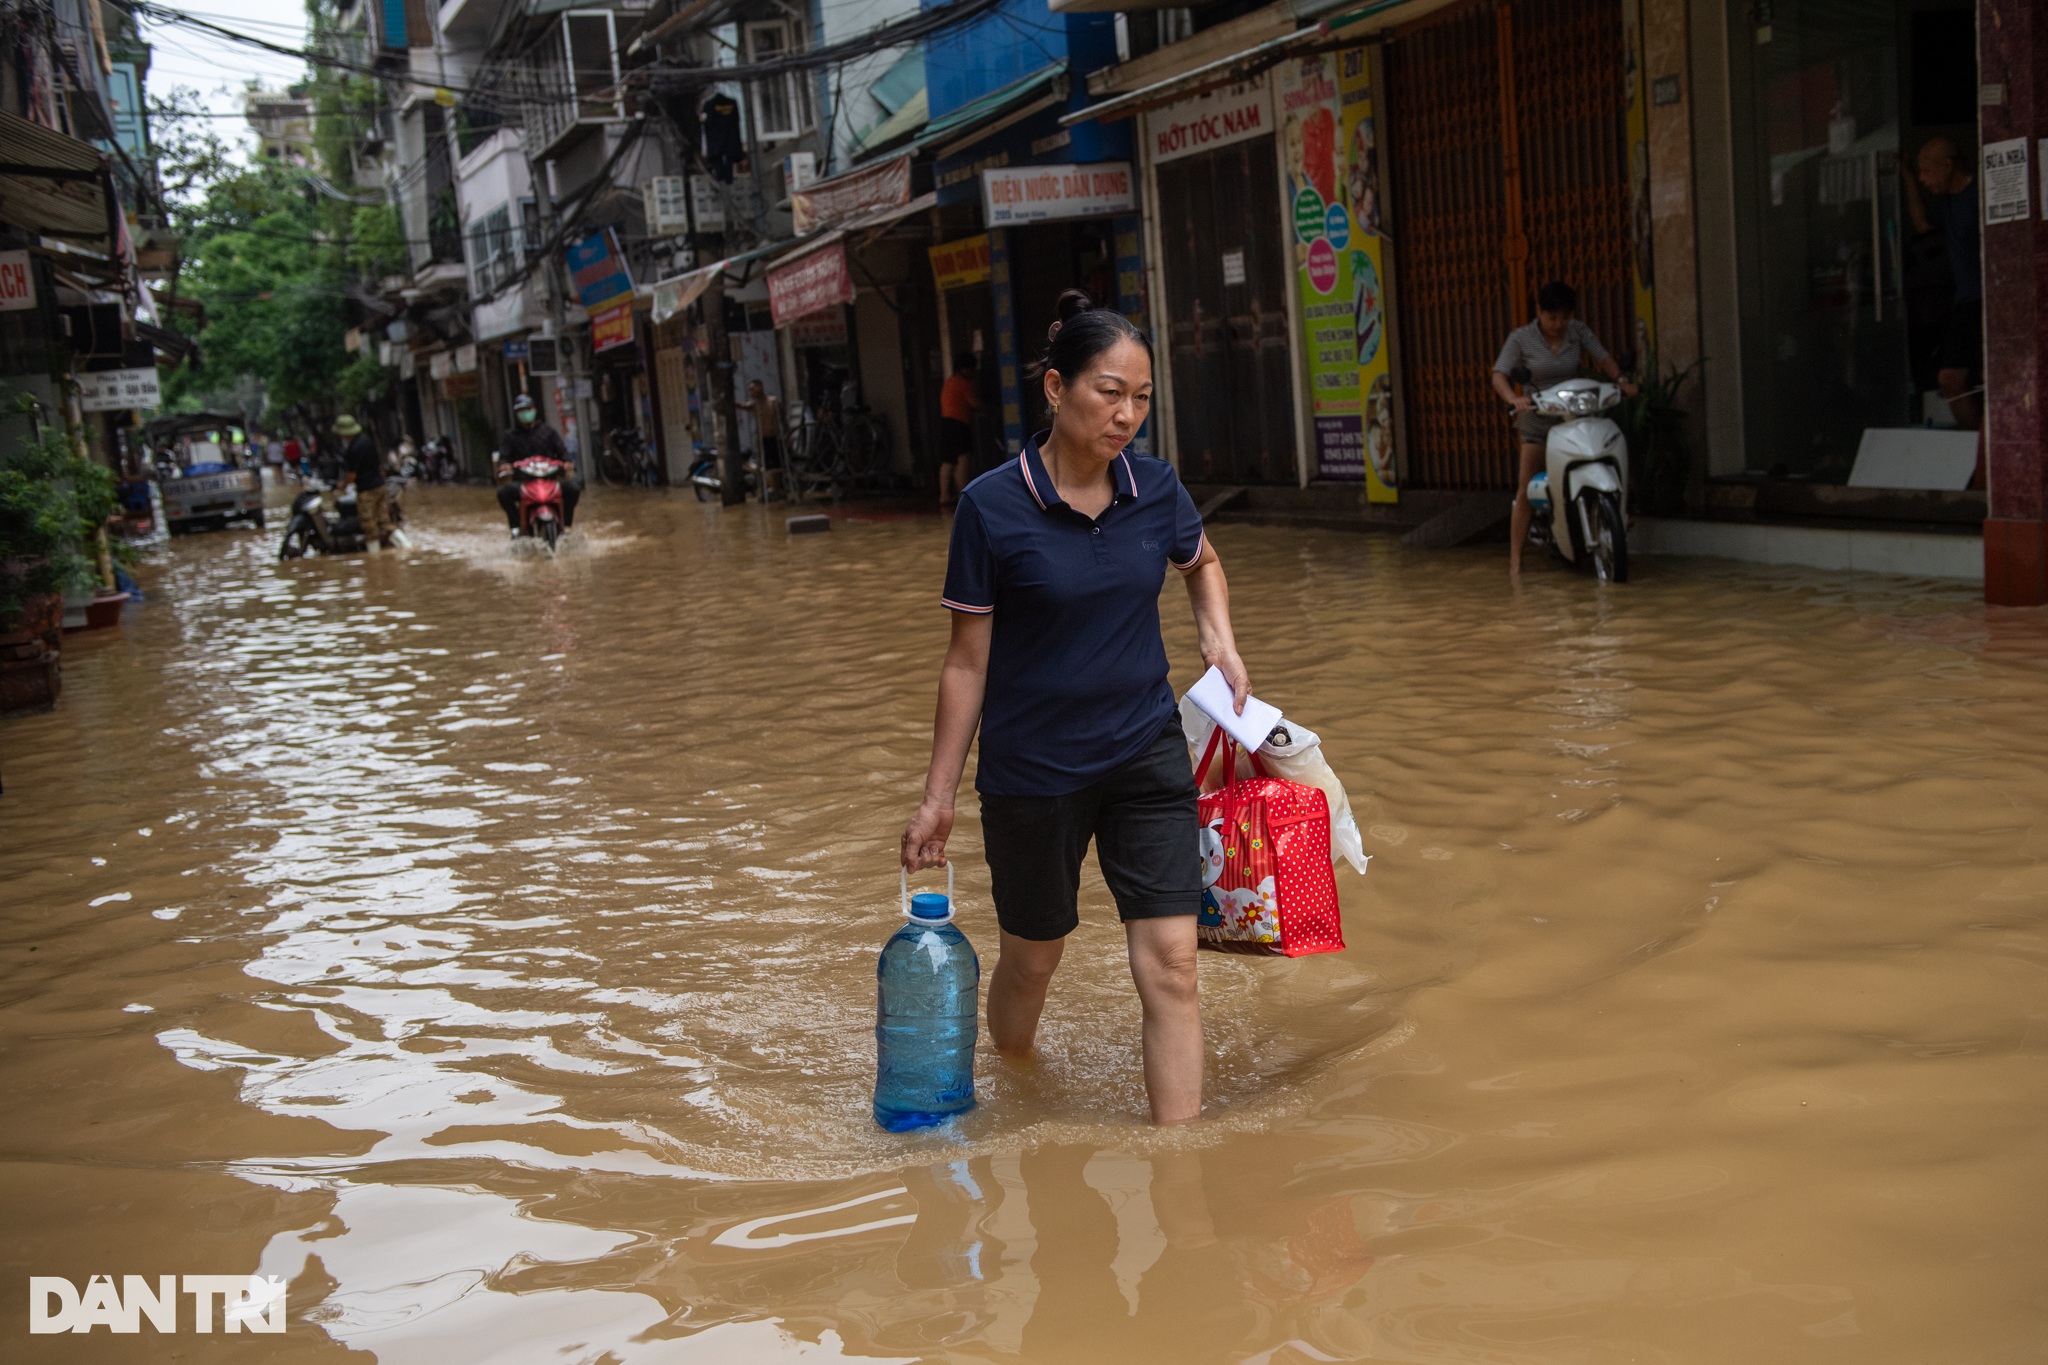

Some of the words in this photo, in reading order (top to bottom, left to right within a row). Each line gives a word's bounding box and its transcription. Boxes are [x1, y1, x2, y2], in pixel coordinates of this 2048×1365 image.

[1157, 121, 1188, 155] HỚT
[1190, 113, 1222, 146] TÓC
[1222, 103, 1261, 134] NAM
[991, 175, 1023, 209] ĐIỆN
[1024, 172, 1061, 203] NƯỚC
[1062, 169, 1091, 199] DÂN
[1092, 171, 1129, 202] DỤNG
